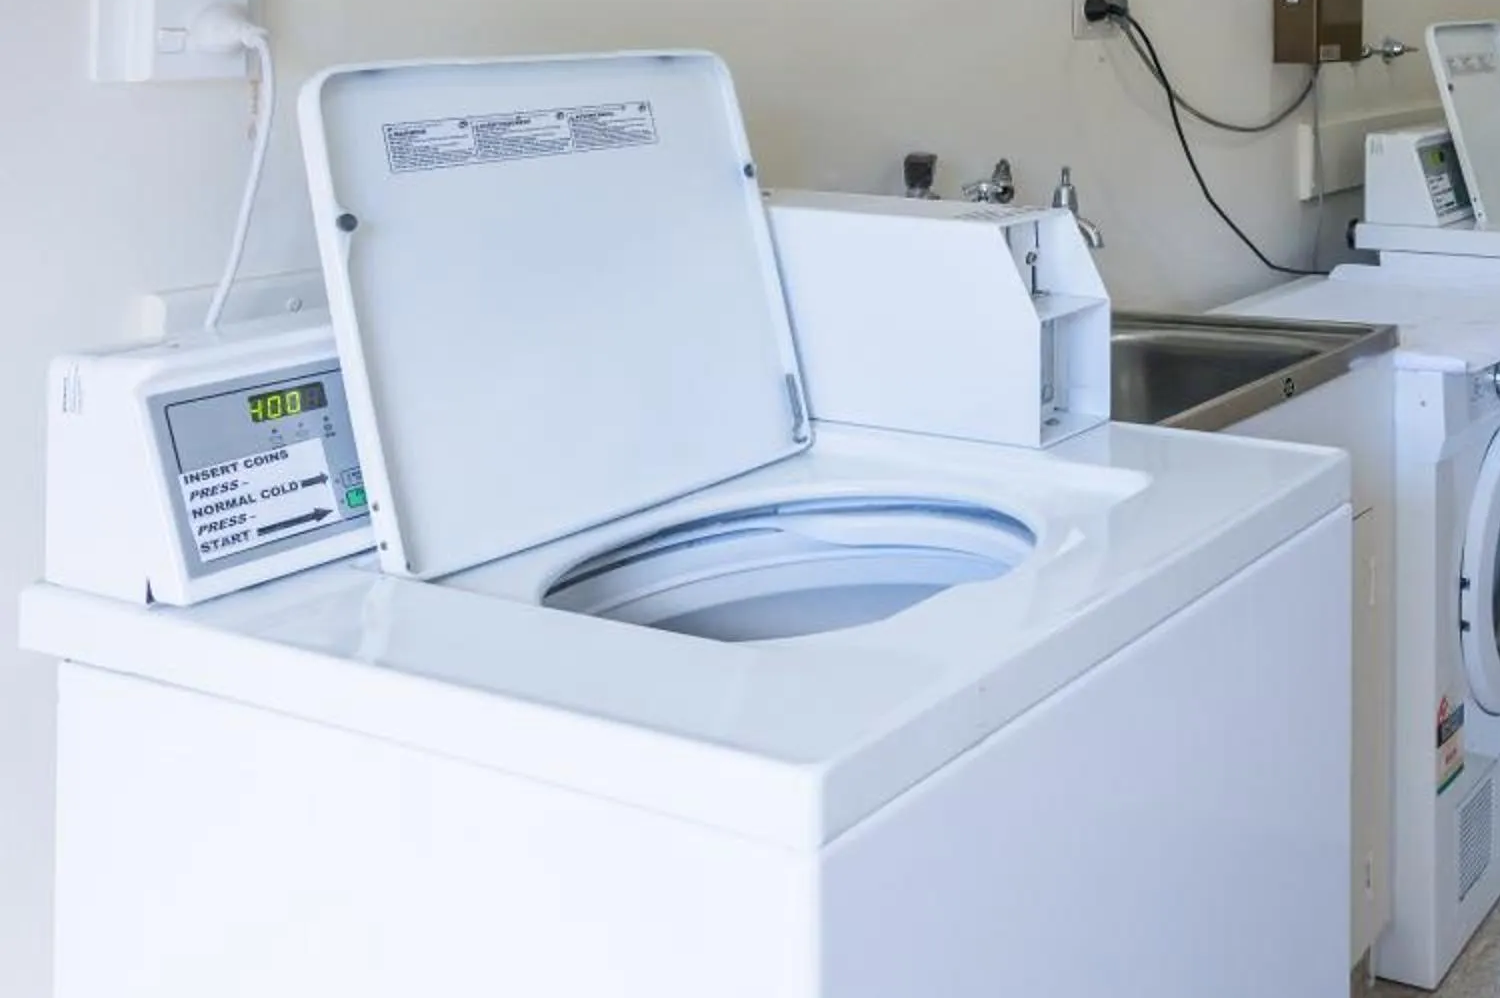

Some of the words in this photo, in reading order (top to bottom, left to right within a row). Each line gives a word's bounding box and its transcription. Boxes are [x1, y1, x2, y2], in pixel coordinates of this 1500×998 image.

[183, 460, 240, 485] INSERT
[243, 449, 290, 470] COINS
[189, 479, 240, 502] PRESS
[191, 493, 257, 520] NORMAL
[260, 481, 300, 500] COLD
[197, 513, 248, 537] PRESS
[199, 529, 251, 554] START
